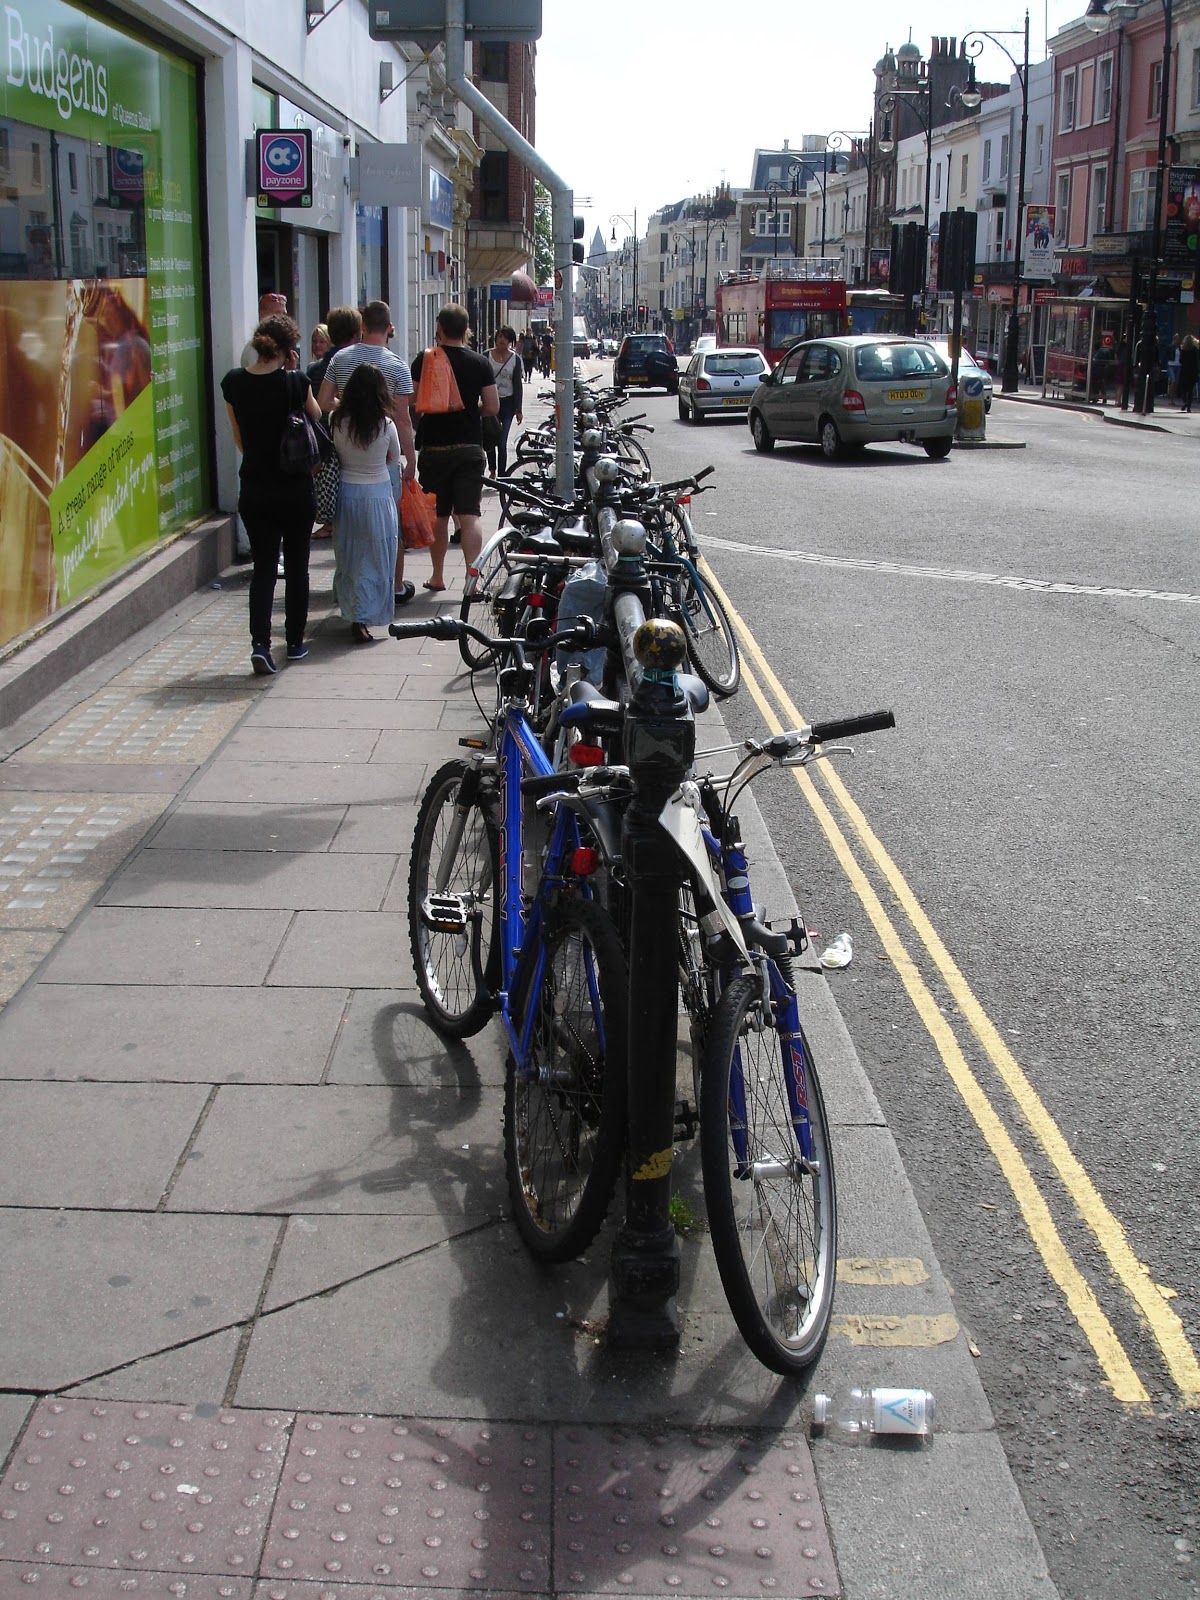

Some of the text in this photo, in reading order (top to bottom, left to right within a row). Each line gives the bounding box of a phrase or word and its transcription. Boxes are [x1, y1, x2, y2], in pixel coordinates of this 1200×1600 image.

[4, 5, 108, 120] Budgens
[265, 176, 302, 187] payzone
[1170, 172, 1195, 180] Brighton
[58, 431, 134, 535] A great range of wines
[63, 452, 155, 597] specially selected for you
[790, 1045, 808, 1110] RST
